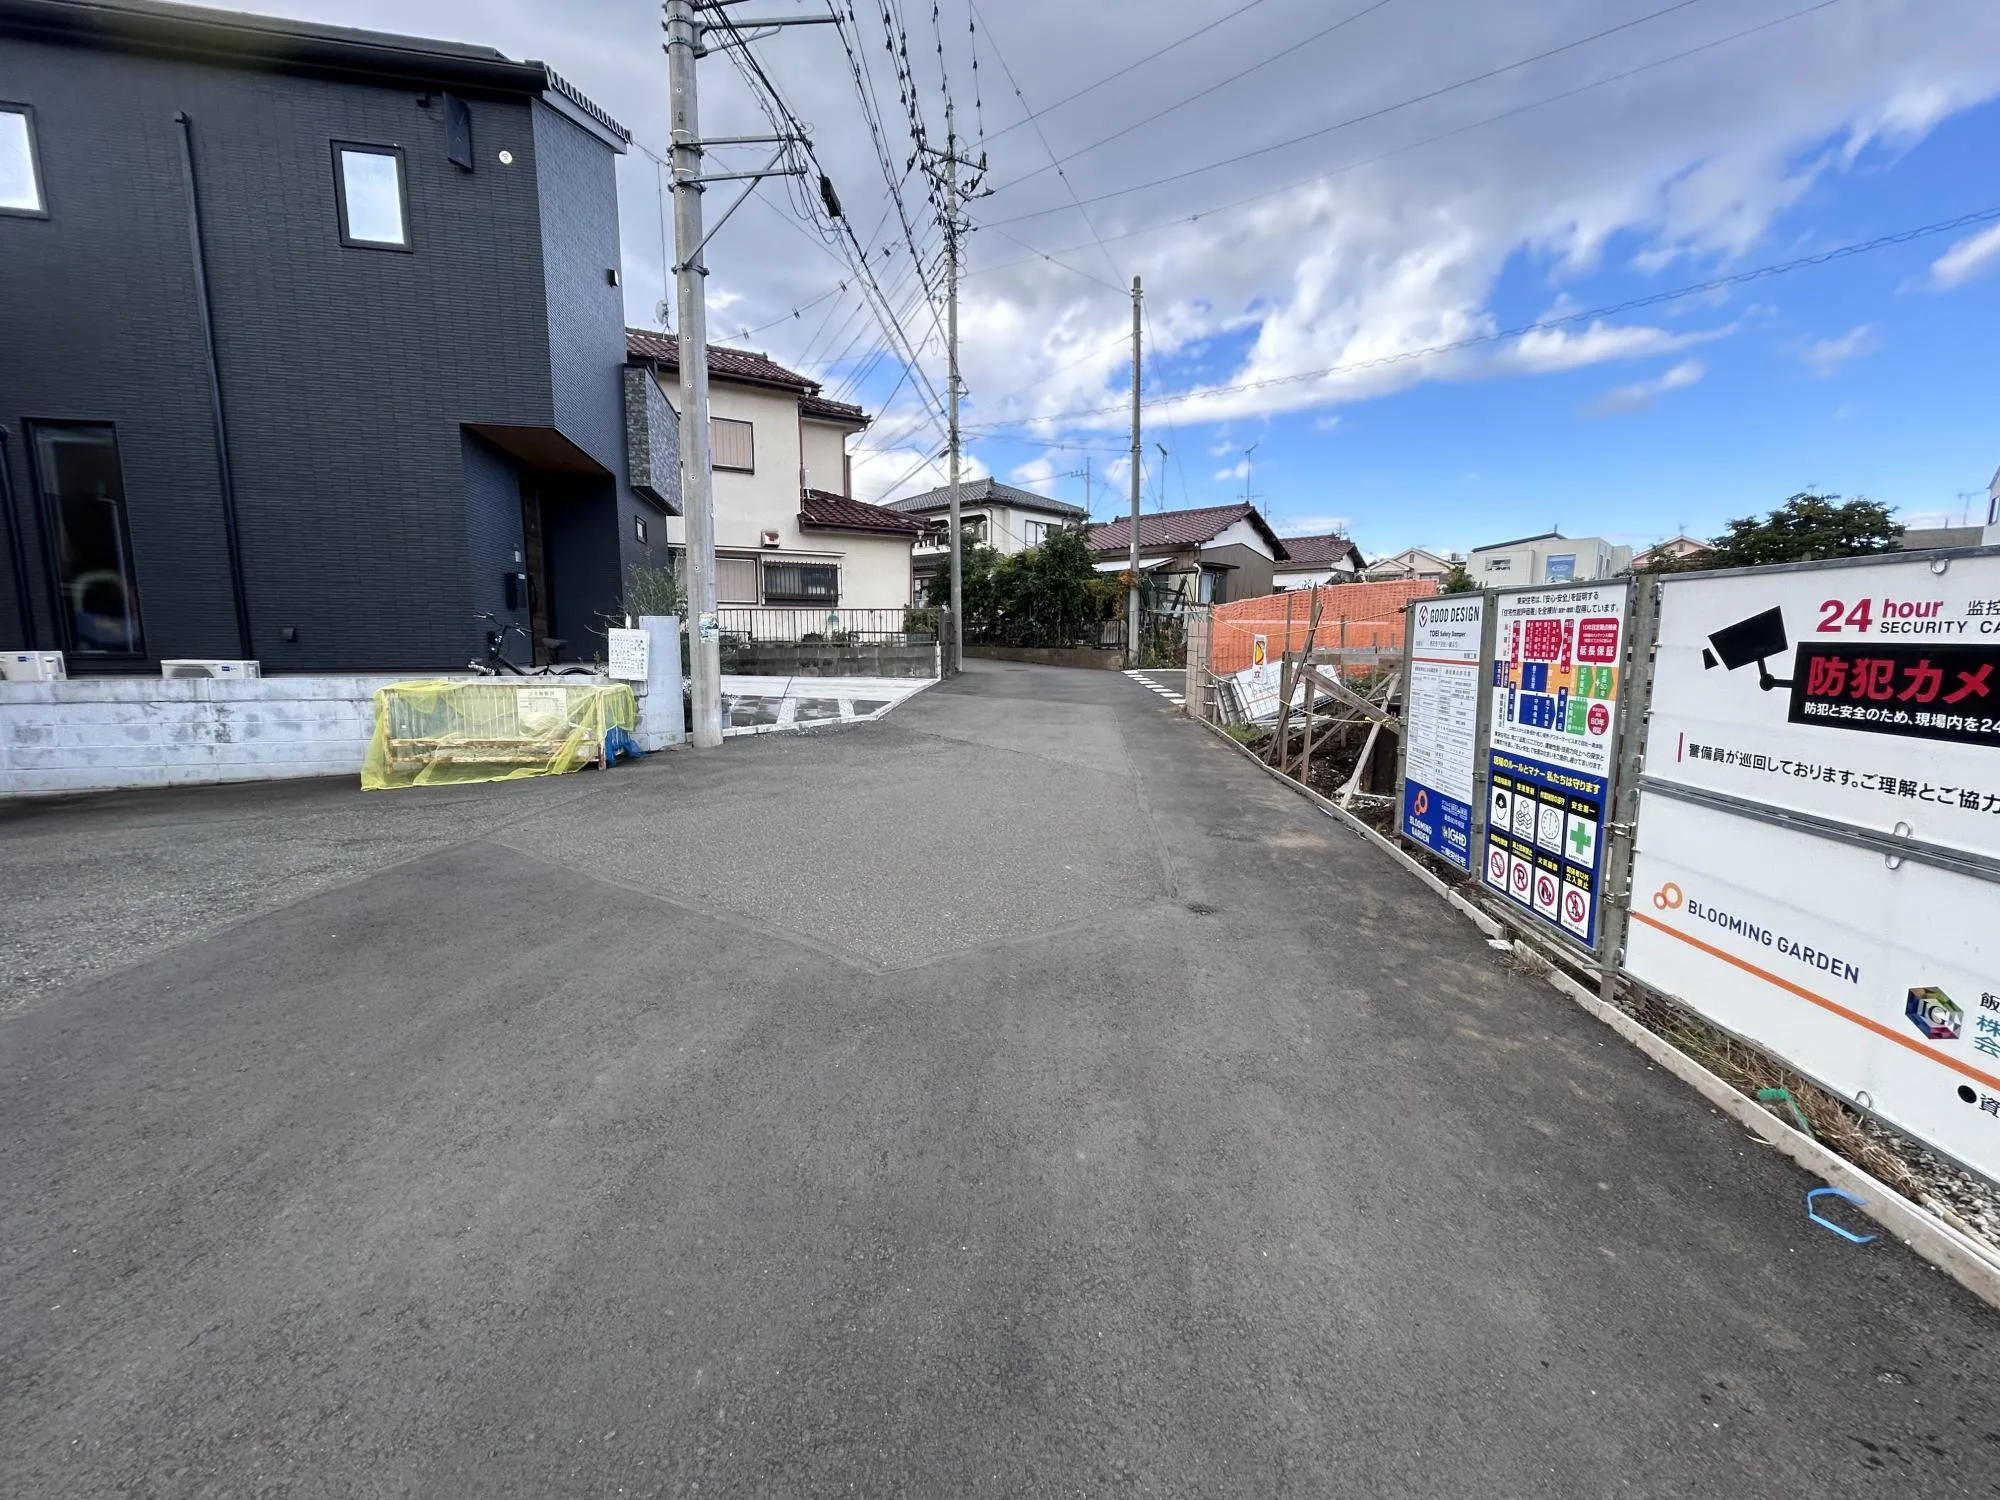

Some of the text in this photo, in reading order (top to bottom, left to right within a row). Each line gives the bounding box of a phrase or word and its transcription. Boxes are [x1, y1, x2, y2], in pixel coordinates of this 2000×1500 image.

[1430, 606, 1480, 623] GOOD DESIGN
[1816, 598, 1944, 633] 24 hour
[1880, 621, 1968, 634] SECURITY
[1806, 656, 1995, 704] 防犯カメ
[1804, 701, 2000, 733] 防犯と安全のため、現場内を24
[1688, 743, 2000, 815] 警備員が巡回しております。ご理解とご協力
[1571, 801, 1596, 814] 安全第一
[1688, 899, 1860, 984] BLOOMING GARDEN
